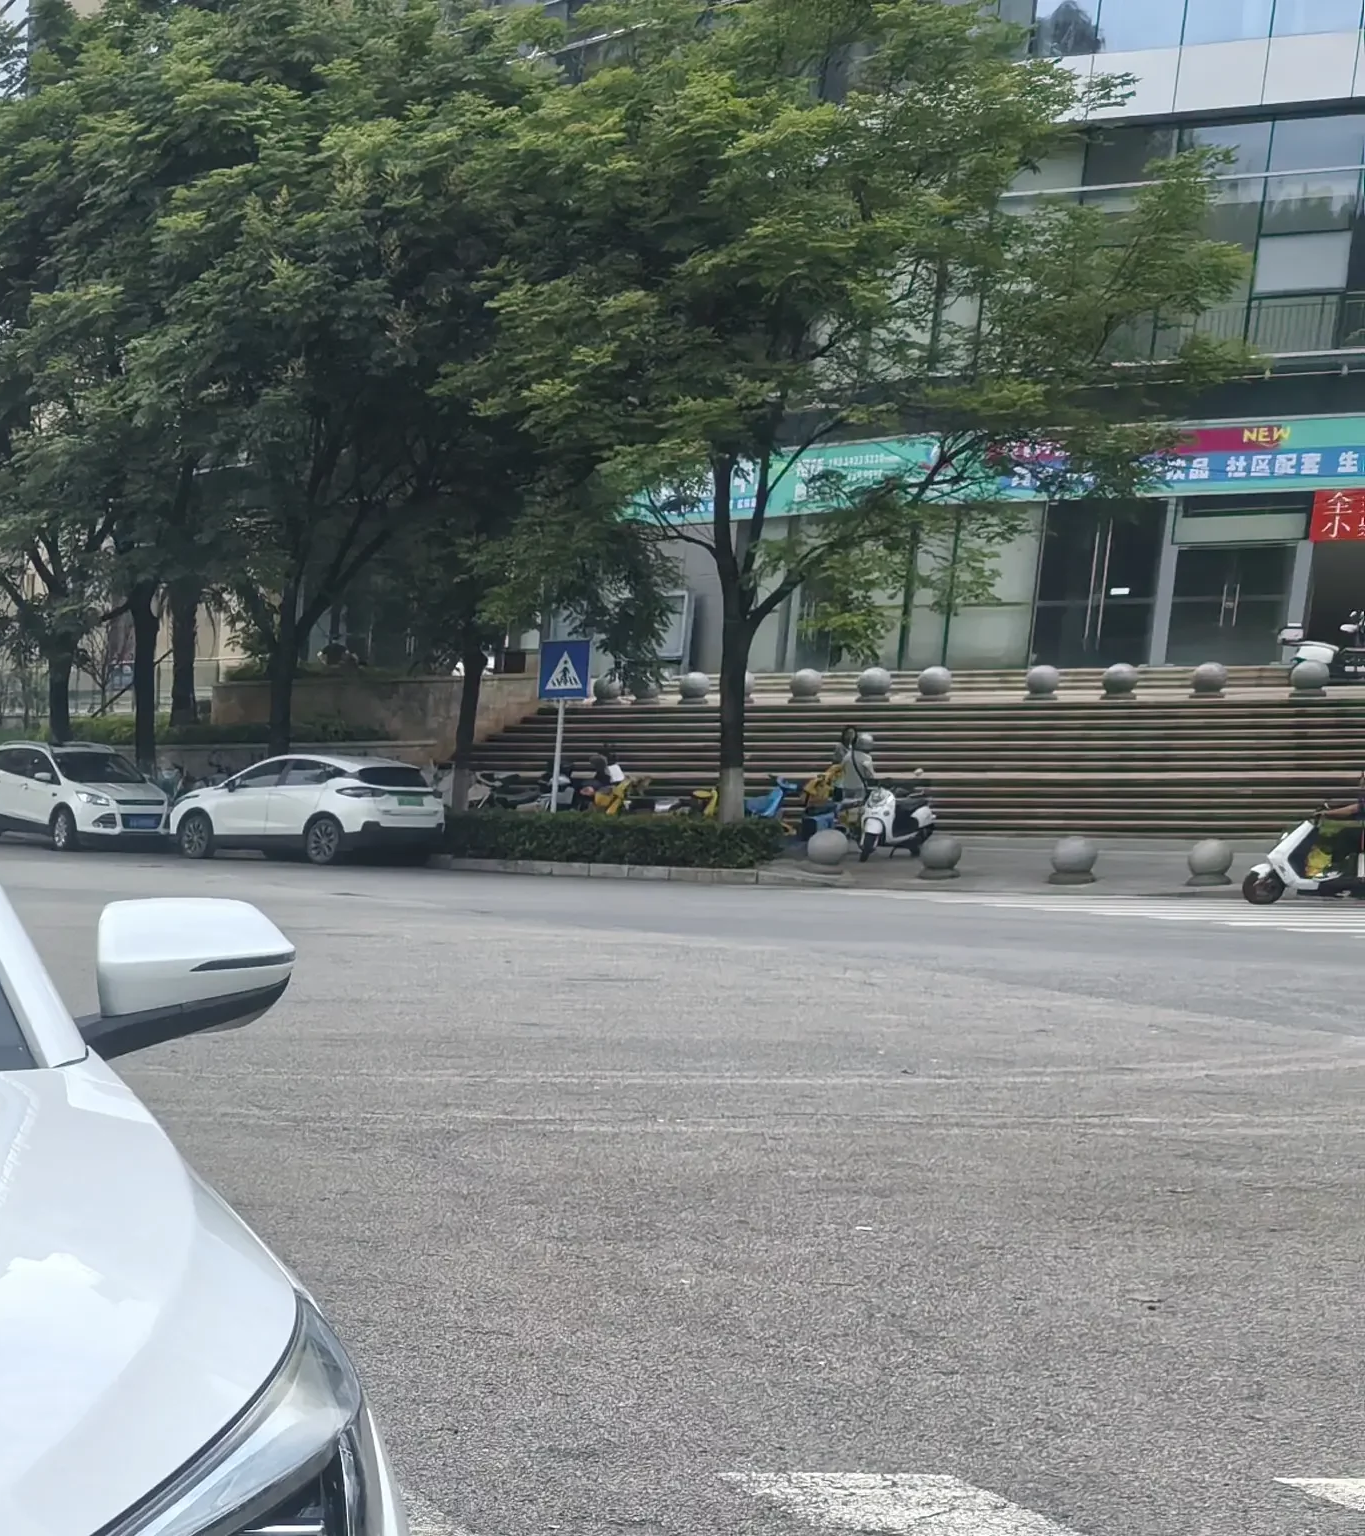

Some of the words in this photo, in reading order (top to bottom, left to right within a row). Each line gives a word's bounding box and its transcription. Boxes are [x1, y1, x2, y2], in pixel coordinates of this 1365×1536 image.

[1242, 426, 1291, 443] NEW
[1225, 453, 1322, 478] 社区配套
